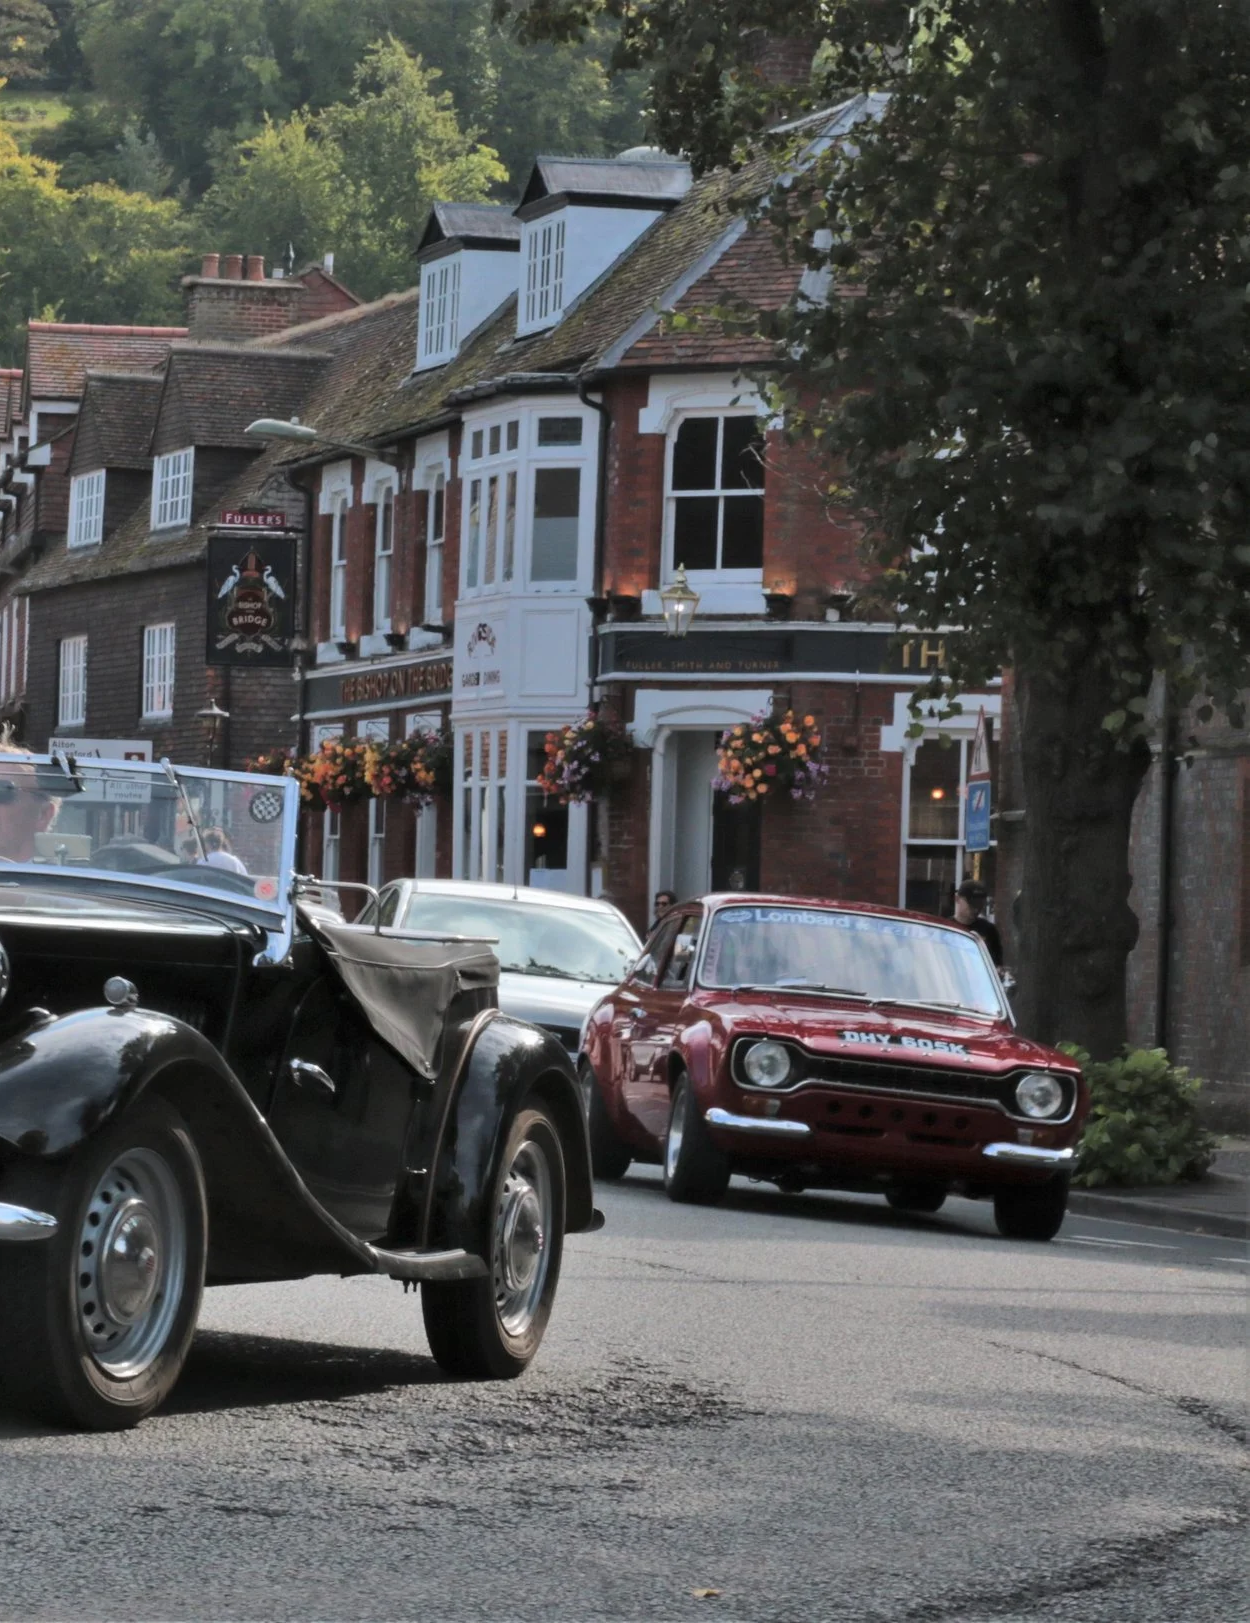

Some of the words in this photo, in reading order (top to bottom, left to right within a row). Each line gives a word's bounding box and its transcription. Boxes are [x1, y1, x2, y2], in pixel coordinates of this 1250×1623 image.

[225, 513, 282, 525] FULLER'S
[231, 614, 268, 627] BRIDGE
[391, 669, 406, 697] ON
[51, 740, 76, 748] Alton
[754, 908, 851, 927] Lombard
[842, 1030, 891, 1045] DHY
